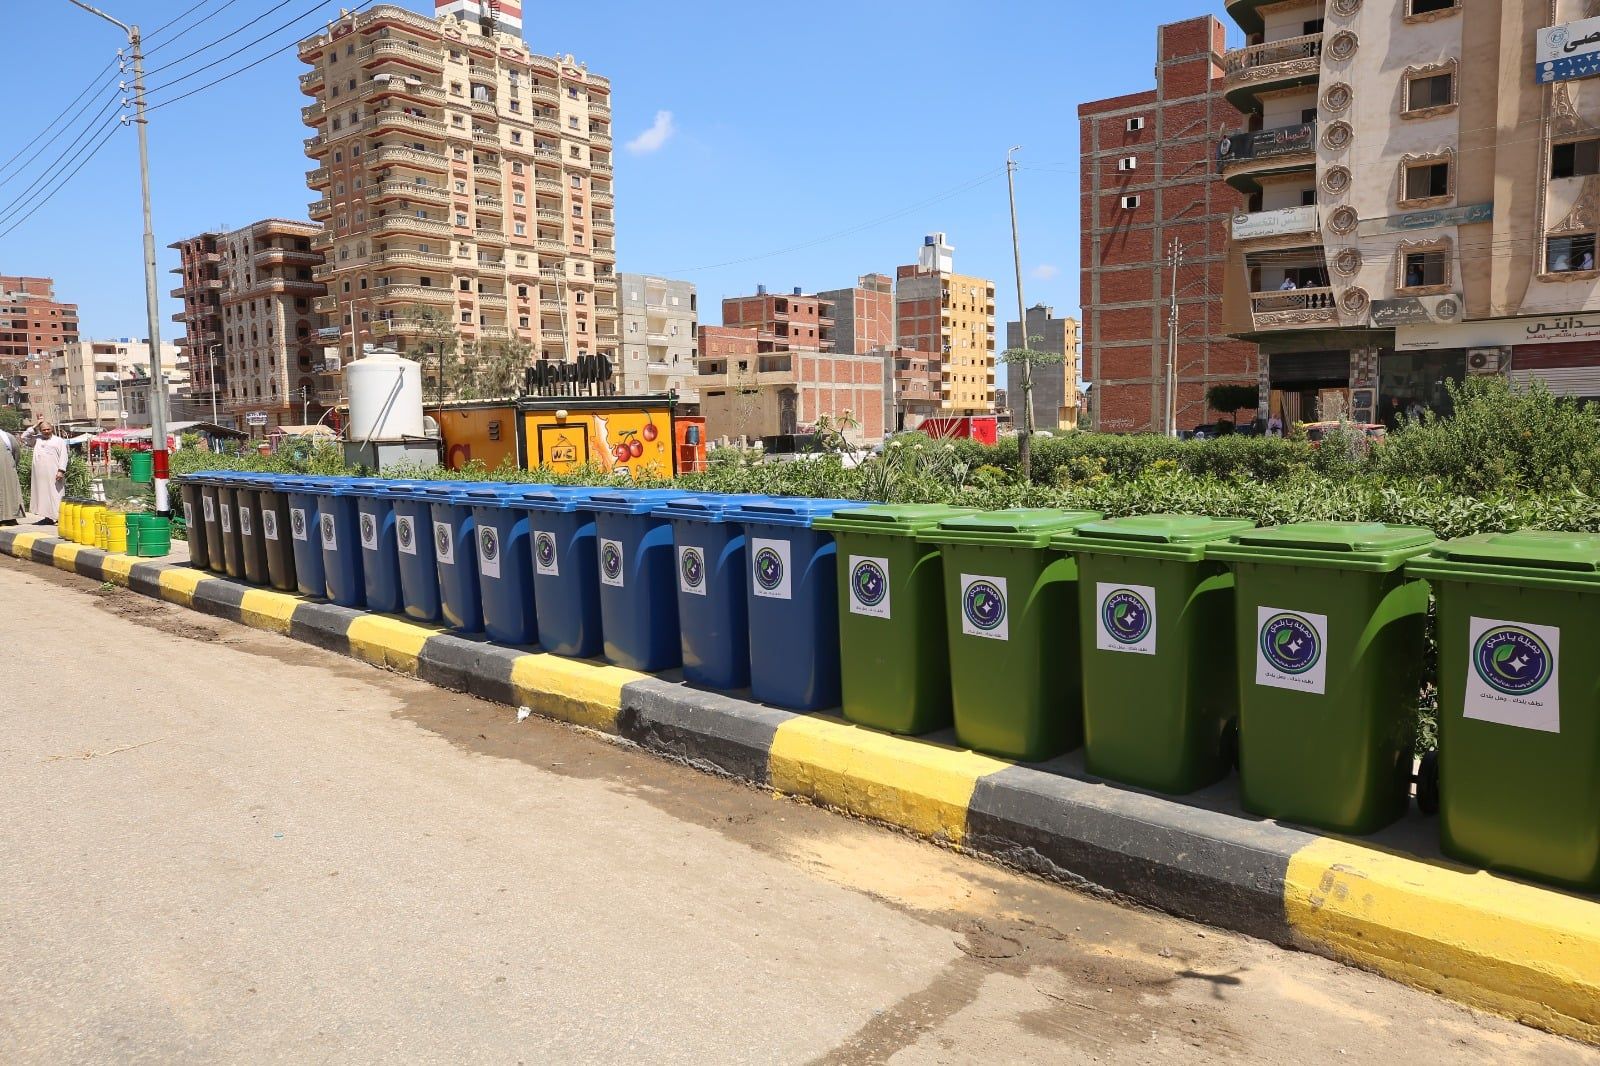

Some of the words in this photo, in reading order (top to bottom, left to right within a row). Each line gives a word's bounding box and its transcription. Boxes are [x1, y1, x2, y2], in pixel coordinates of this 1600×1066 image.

[1486, 632, 1506, 650] بلدي
[1506, 632, 1516, 642] يا
[1518, 636, 1540, 654] جميلة
